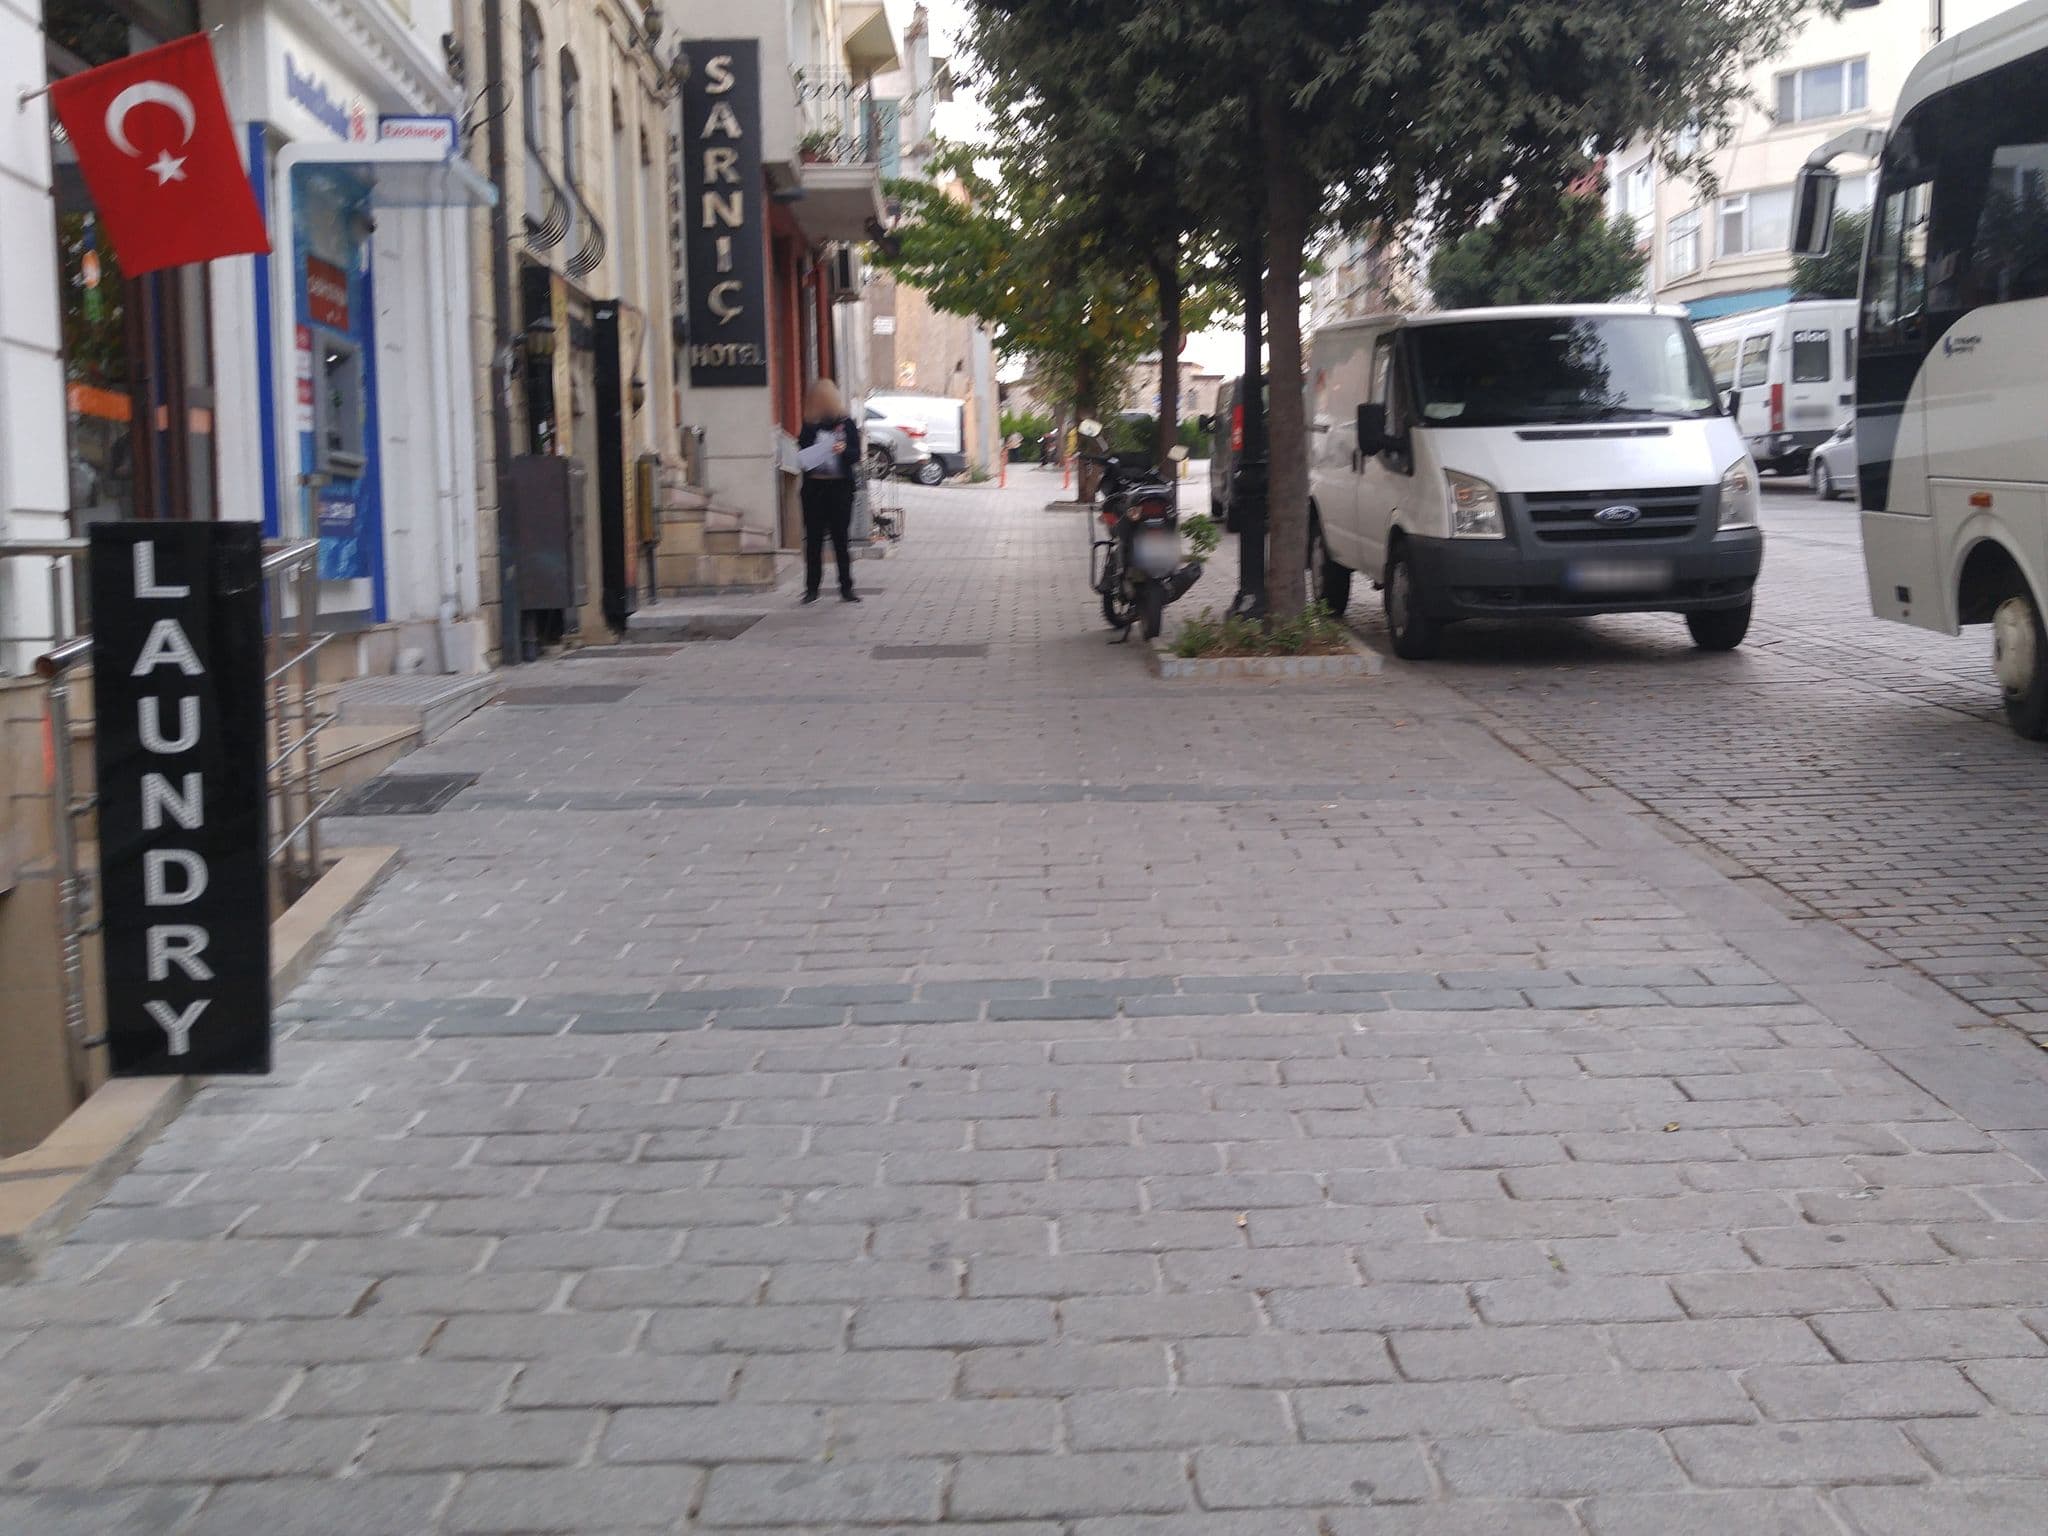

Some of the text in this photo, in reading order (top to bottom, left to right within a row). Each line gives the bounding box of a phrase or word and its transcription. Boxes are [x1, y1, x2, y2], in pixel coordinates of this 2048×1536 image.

[700, 54, 744, 326] SARNIÇ
[690, 343, 767, 367] HOTEL
[130, 540, 216, 1057] LAUNDRY
